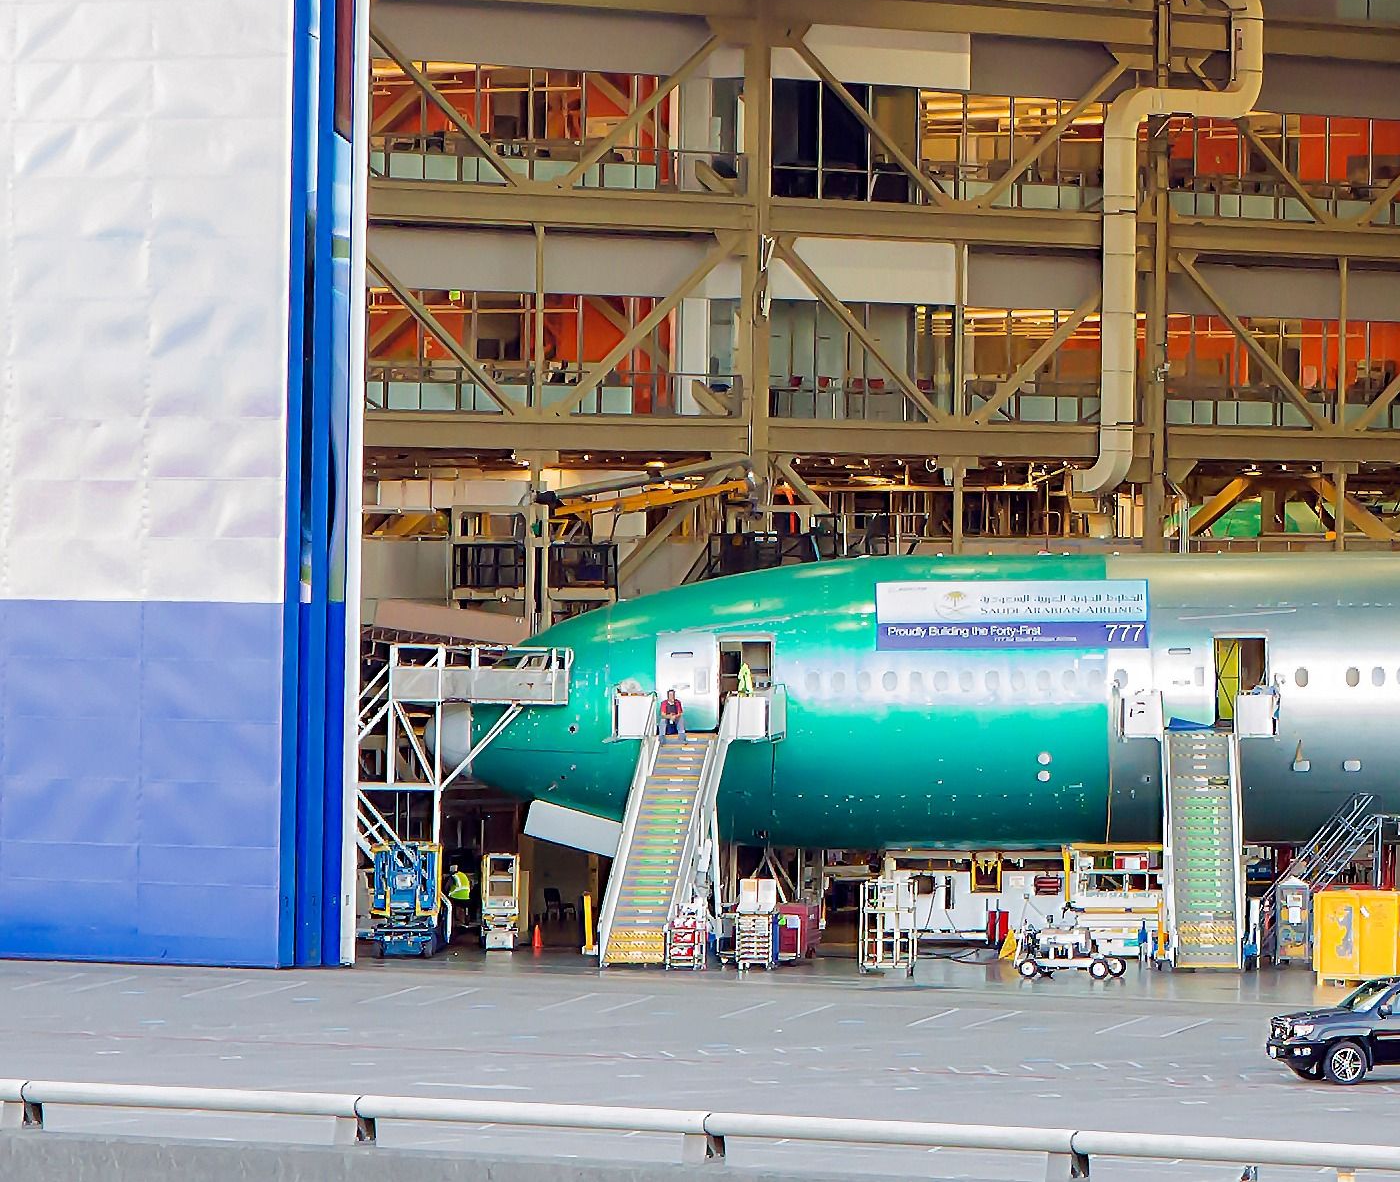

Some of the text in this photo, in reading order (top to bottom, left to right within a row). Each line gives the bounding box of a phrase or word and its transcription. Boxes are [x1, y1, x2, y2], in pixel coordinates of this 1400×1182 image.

[1024, 606, 1081, 615] ARABIAN
[1086, 605, 1144, 615] AIRLINES
[887, 625, 1042, 639] Proudly Building the Forty-First
[1105, 623, 1146, 643] 777
